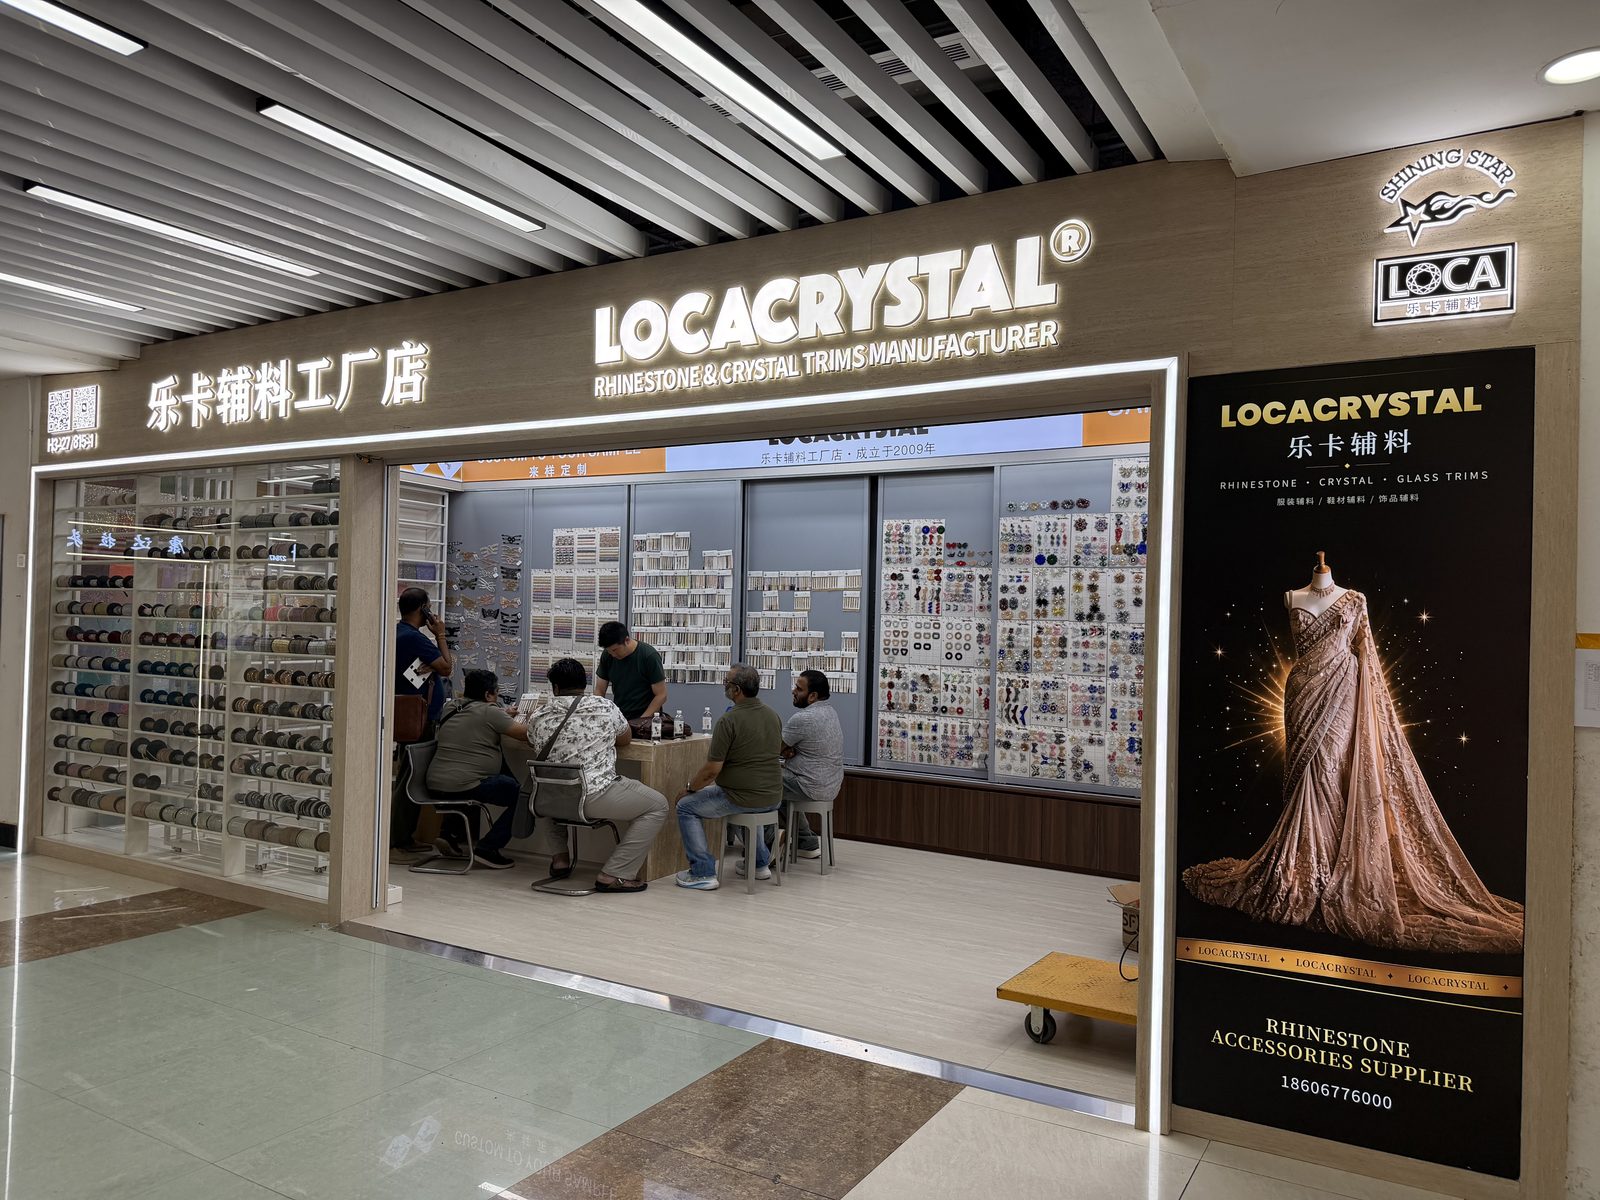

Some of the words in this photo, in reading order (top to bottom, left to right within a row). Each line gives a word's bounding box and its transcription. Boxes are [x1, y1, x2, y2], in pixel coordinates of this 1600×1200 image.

[1381, 149, 1462, 200] SHINING
[1467, 149, 1514, 185] STAR
[1389, 255, 1501, 299] LOCA
[594, 235, 1058, 366] LOCACRYSTAL
[1407, 296, 1480, 316] 乐卡辅料
[594, 364, 702, 398] RHINESTONE
[720, 354, 801, 385] CRYSTAL
[803, 343, 867, 375] TRIMS
[869, 320, 1059, 367] MANUFACTURER
[147, 340, 430, 432] 乐卡辅料工厂店
[1221, 386, 1483, 428] LOCACRYSTAL
[1287, 428, 1412, 460] 乐卡辅料
[528, 462, 588, 478] 来样定制
[1219, 479, 1298, 490] RHINESTONE
[1318, 476, 1375, 487] CRYSTAL
[1396, 473, 1440, 484] GLASS
[1445, 470, 1490, 481] TRIMS
[1198, 946, 1270, 963] LOCACRYSTAL
[1296, 958, 1377, 979] LOCACRYSTAL
[1407, 974, 1490, 991] LOCACRYSTAL
[1265, 1017, 1411, 1059] RHINESTONE
[1210, 1029, 1353, 1070] ACCESSORIES
[1359, 1057, 1474, 1093] SUPPLIER
[1280, 1075, 1393, 1111] 18606776000
